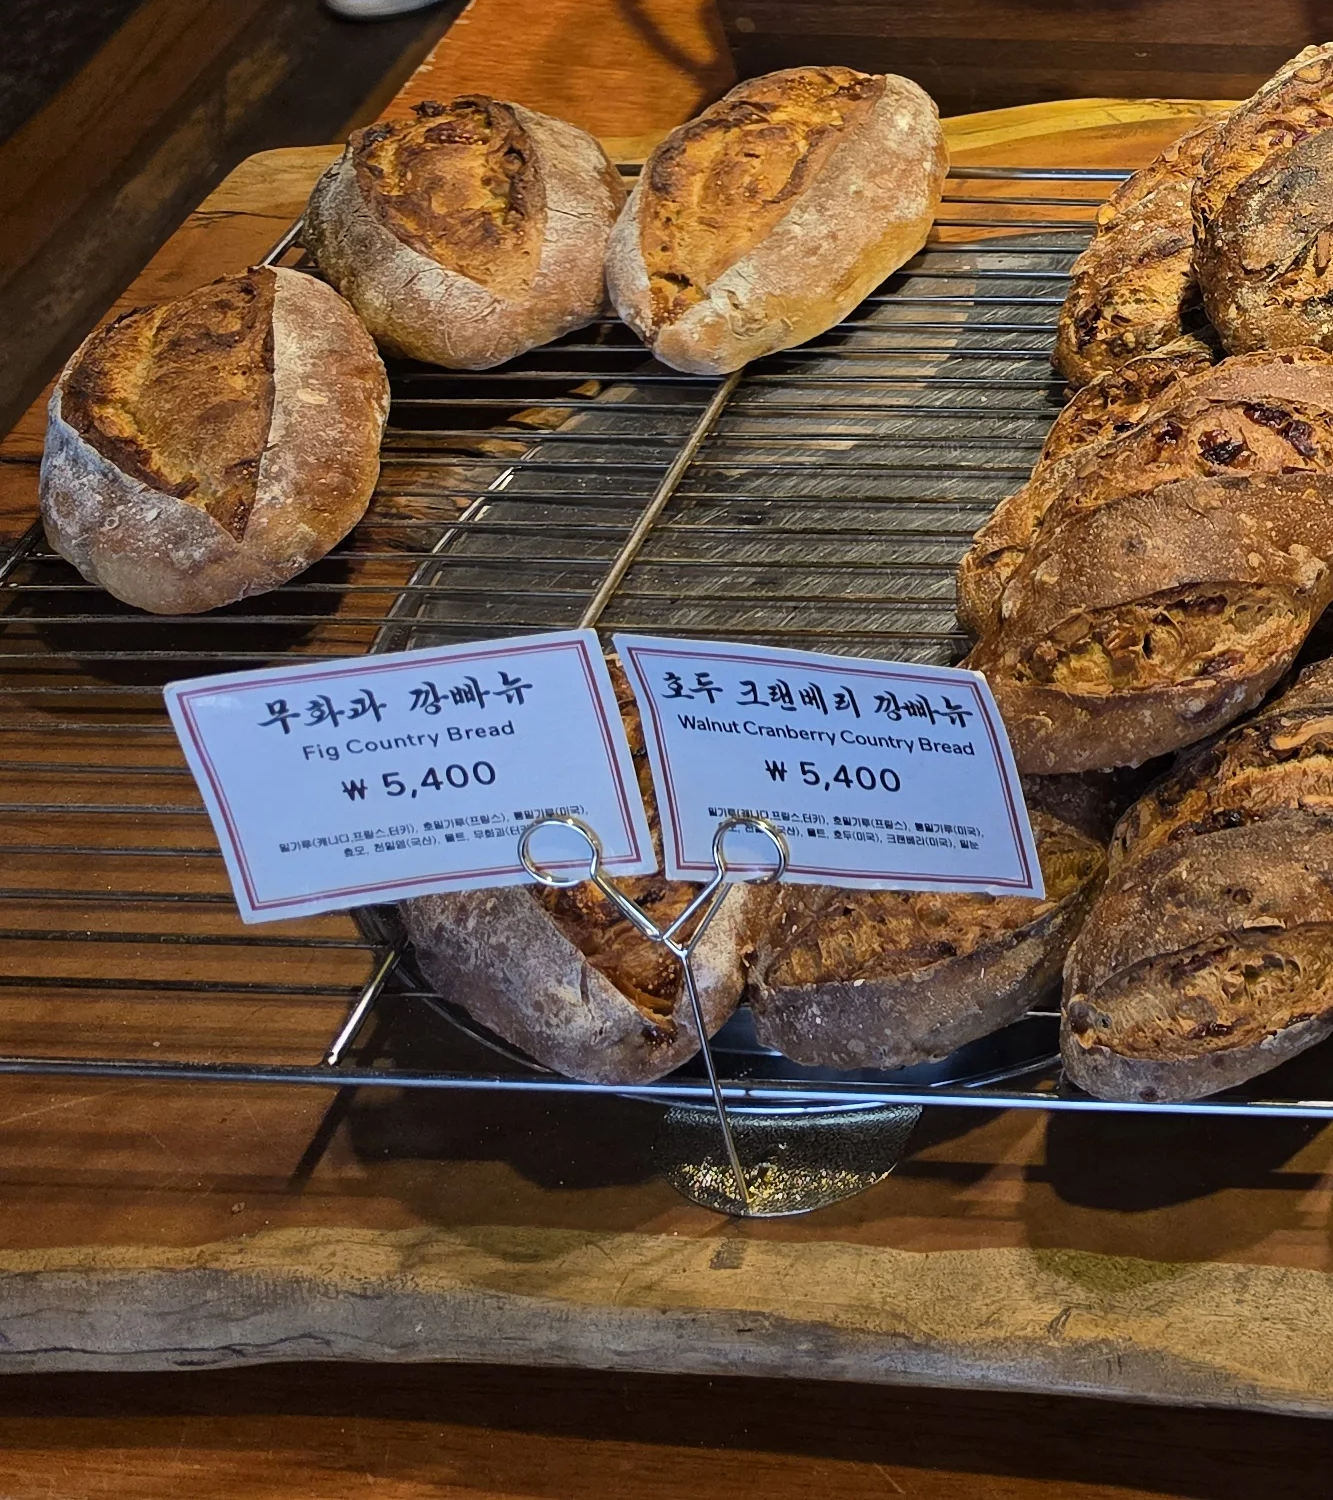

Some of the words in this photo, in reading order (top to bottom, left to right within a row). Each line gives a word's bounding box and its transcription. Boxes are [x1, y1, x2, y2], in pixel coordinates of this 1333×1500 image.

[257, 689, 387, 735] 무화과
[409, 670, 533, 715] 깡빠뉴
[661, 672, 723, 704] 호두
[736, 679, 860, 718] 크랜베리
[874, 691, 973, 729] 깡빠뉴
[302, 745, 340, 762] Fig
[346, 730, 439, 754] Country
[446, 720, 516, 742] Bread
[678, 714, 740, 735] Walnut
[743, 721, 836, 746] Cranberry
[840, 730, 914, 753] Country
[918, 737, 975, 757] Bread
[382, 760, 496, 799] 5,400
[800, 761, 901, 793] 5,400
